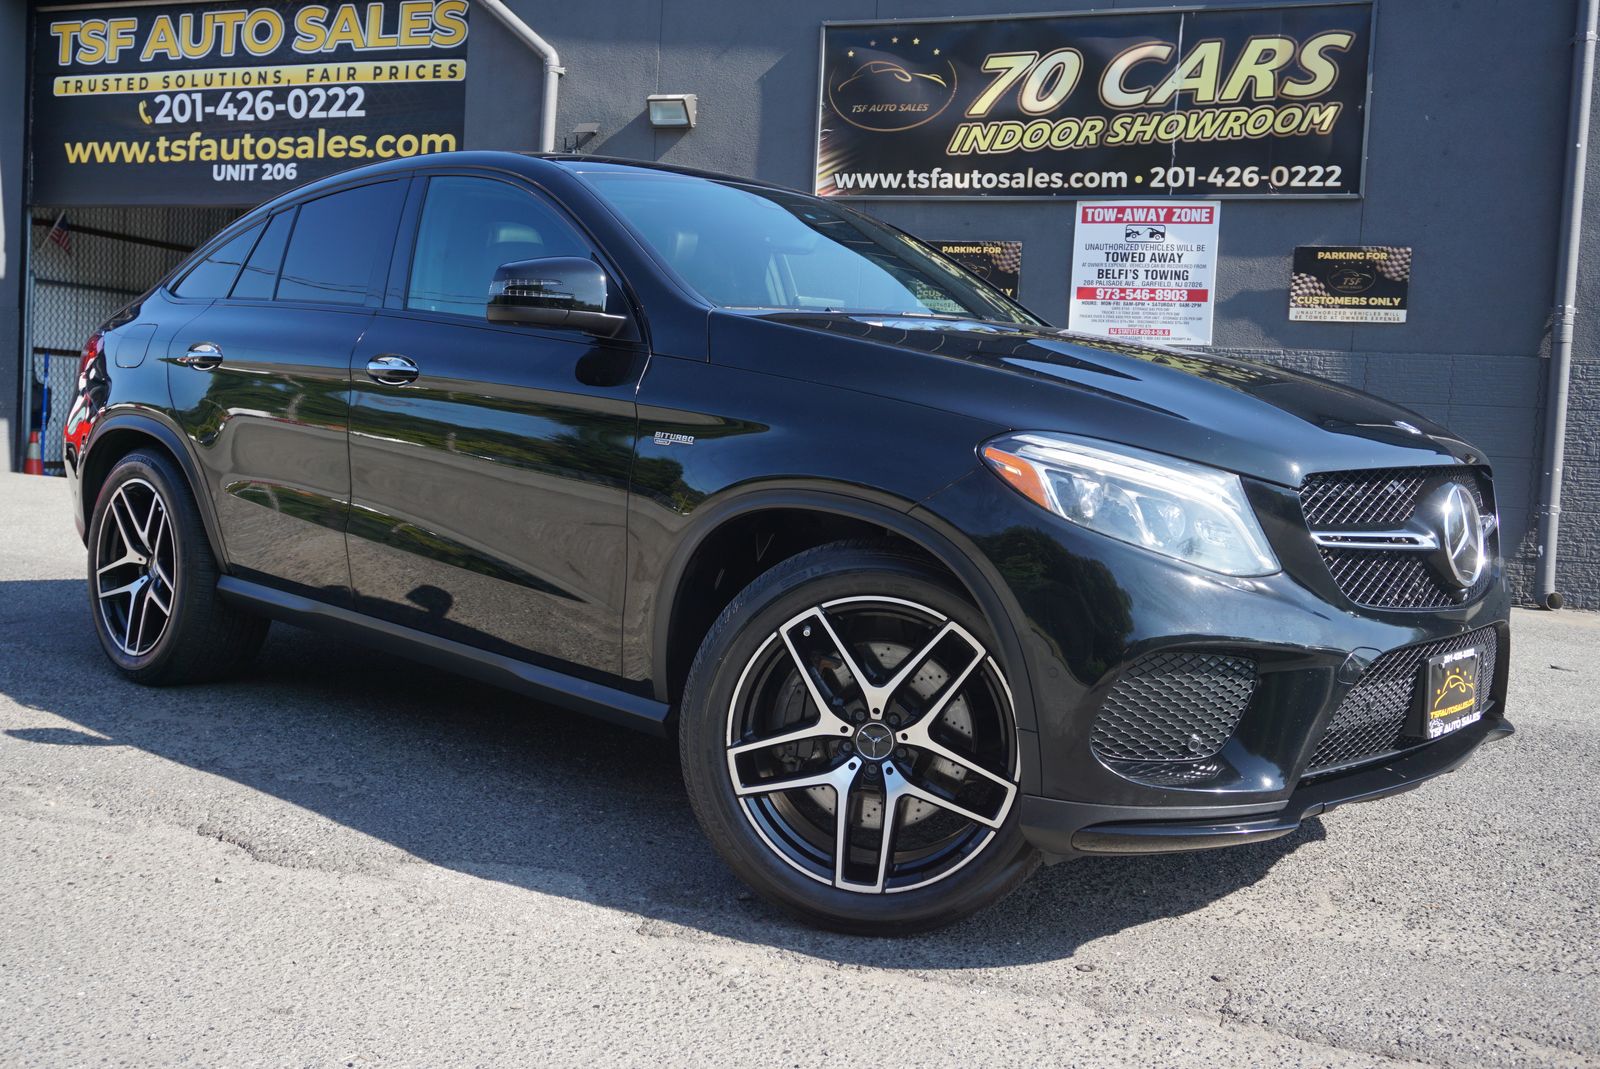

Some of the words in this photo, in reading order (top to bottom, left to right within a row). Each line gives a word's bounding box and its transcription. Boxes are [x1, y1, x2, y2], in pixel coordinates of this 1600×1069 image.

[51, 18, 137, 65] TSF
[140, 7, 285, 62] AUTO
[292, 0, 469, 53] SALES
[62, 77, 149, 93] TRUSTED
[162, 70, 292, 88] SOLUTIONS,
[306, 67, 358, 82] FAIR
[373, 64, 459, 80] PRICES
[967, 47, 1084, 117] 70
[1099, 30, 1357, 107] CARS
[154, 87, 366, 124] 201-426-0222
[852, 105, 868, 113] TSF
[869, 104, 896, 112] AUTO
[898, 103, 929, 111] SALES
[946, 119, 1103, 156] INDOOR
[1106, 102, 1343, 146] SHOWROOM
[65, 128, 456, 164] www.tsfautosales.com
[212, 164, 258, 182] UNIT
[261, 162, 297, 180] 206
[834, 167, 1127, 190] www.tsfautosales.com
[1150, 165, 1342, 188] 201-426-0222
[1086, 208, 1167, 222] TOW-AWAY
[1172, 209, 1210, 222] ZONE
[942, 246, 982, 254] PARKING
[983, 246, 1001, 254] FOR
[1085, 243, 1139, 251] UNAUTHORIZED
[1105, 252, 1145, 263] TOWED
[1150, 253, 1184, 263] AWAY
[1317, 251, 1365, 260] PARKING
[1366, 252, 1388, 260] FOR
[1097, 269, 1139, 280] BELFI'S
[1144, 269, 1189, 281] TOWING
[1343, 277, 1363, 286] TSF
[1096, 288, 1188, 300] 973-546-8903
[1297, 296, 1367, 306] CUSTOMERS
[1369, 297, 1401, 306] ONLY
[655, 431, 694, 442] BITURBO
[1429, 725, 1444, 738] TSF
[1443, 719, 1461, 733] AUTO
[1461, 711, 1481, 727] SALES
